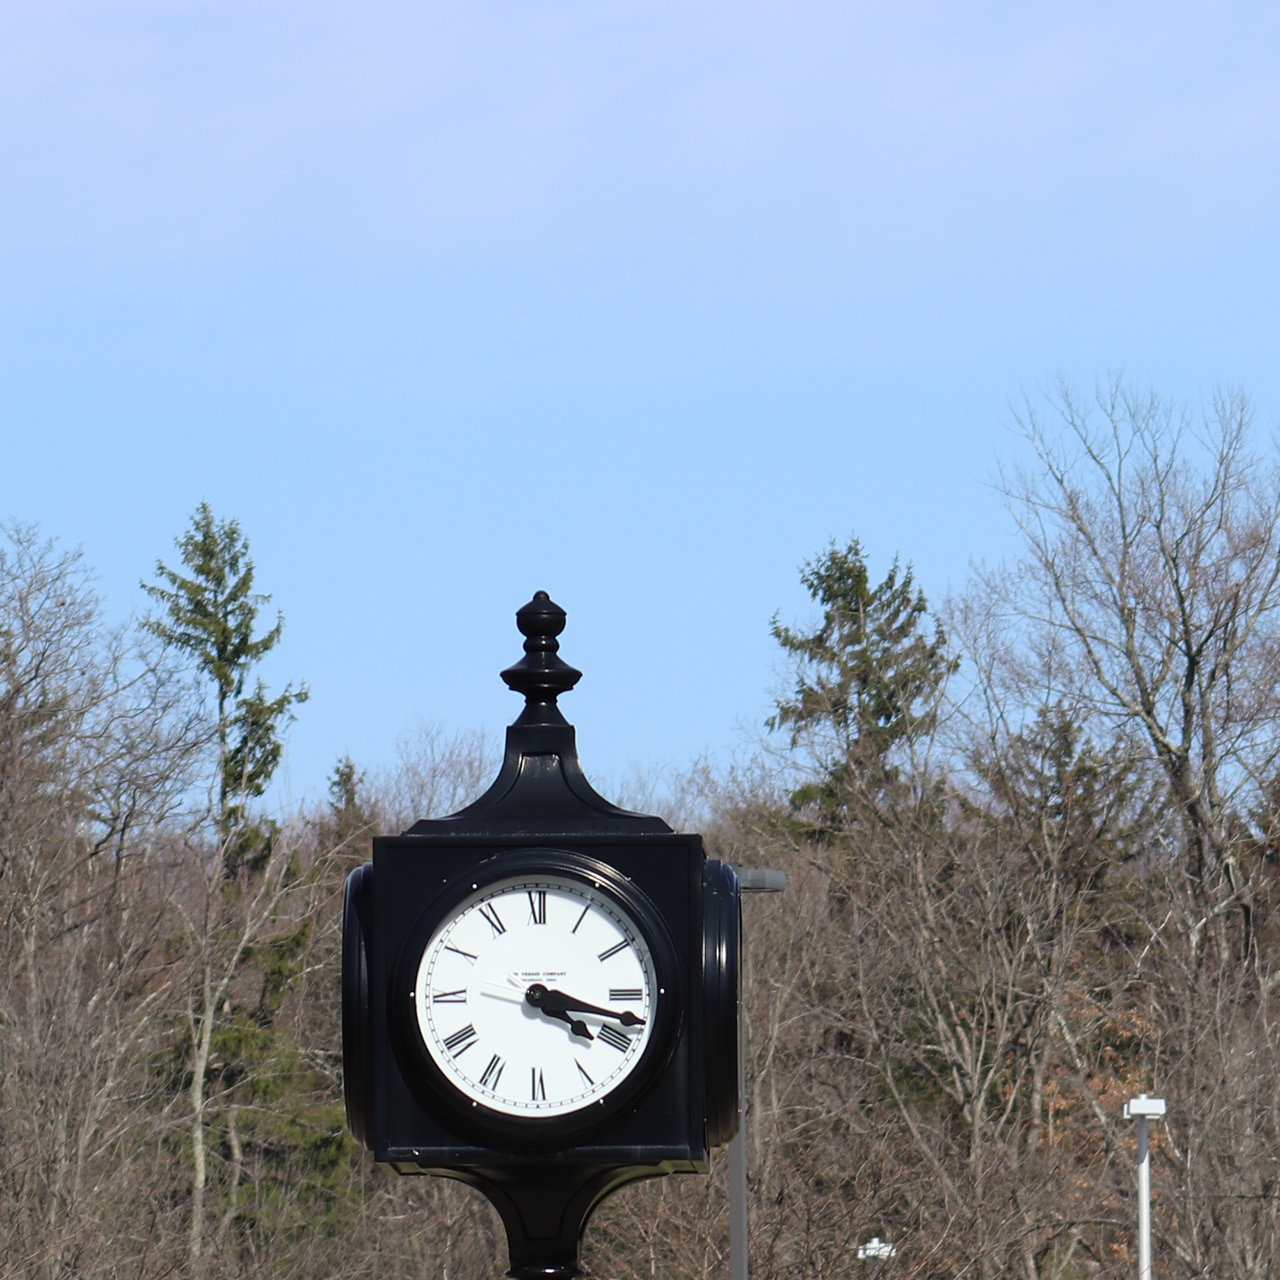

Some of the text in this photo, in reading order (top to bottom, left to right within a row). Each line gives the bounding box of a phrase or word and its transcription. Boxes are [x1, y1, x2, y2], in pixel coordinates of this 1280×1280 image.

[478, 902, 507, 940] XI
[527, 891, 547, 925] XII
[608, 988, 644, 1001] III
